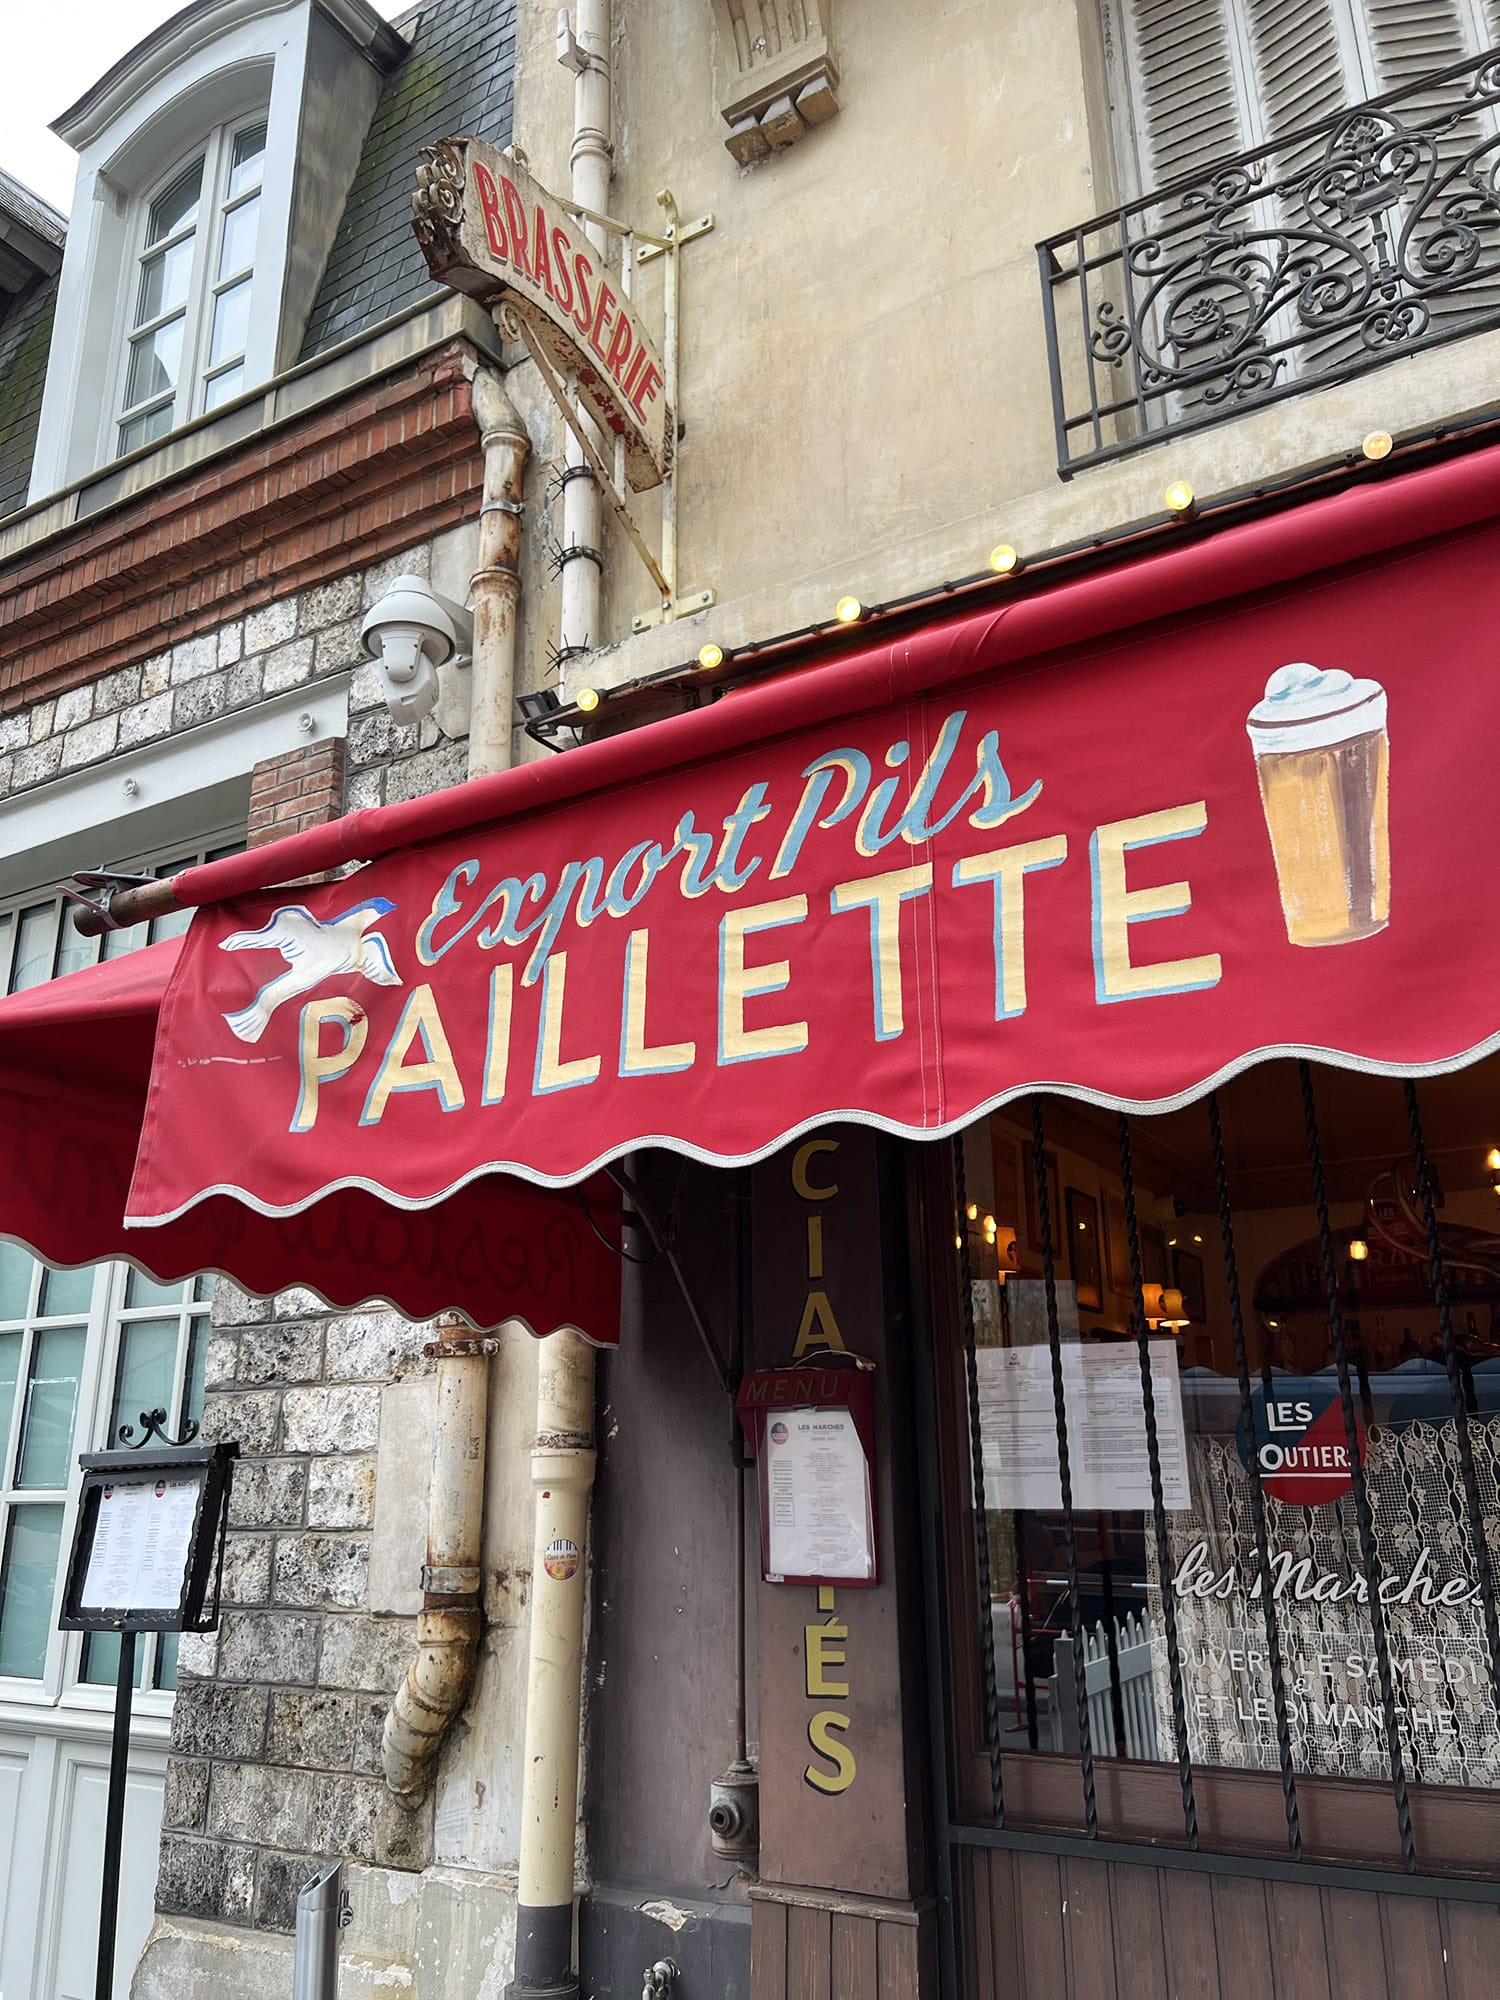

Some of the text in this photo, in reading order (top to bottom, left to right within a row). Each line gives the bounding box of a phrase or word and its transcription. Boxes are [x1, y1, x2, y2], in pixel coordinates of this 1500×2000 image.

[473, 161, 663, 426] BRASSERIE
[416, 710, 1044, 988] Export Pils
[289, 800, 1223, 1133] PAILLETTE
[748, 1377, 839, 1400] MENU
[1266, 1402, 1313, 1432] LES
[1257, 1443, 1352, 1471] OUTIER
[1171, 1541, 1235, 1599] les
[1299, 1653, 1334, 1676] LE
[1194, 1694, 1229, 1719] ET
[1237, 1696, 1271, 1722] LE
